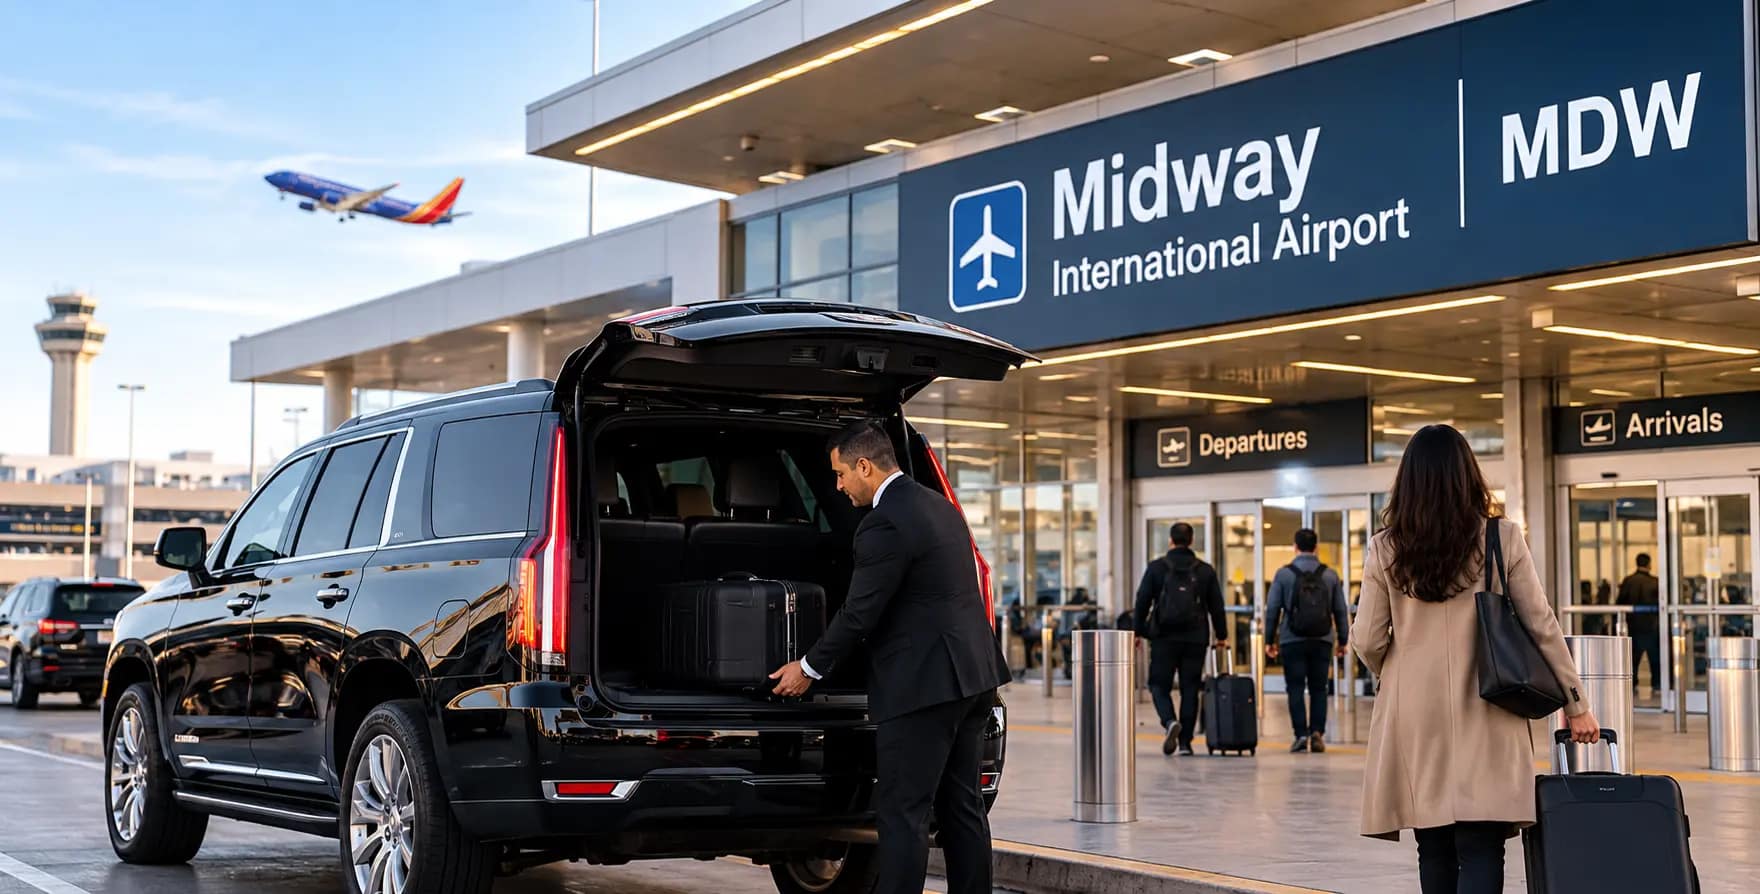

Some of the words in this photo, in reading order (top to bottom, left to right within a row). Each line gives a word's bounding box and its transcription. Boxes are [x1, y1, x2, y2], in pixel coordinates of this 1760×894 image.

[1502, 71, 1702, 184] MDW
[1053, 126, 1321, 240] Midway
[1053, 222, 1260, 297] International
[1272, 198, 1410, 261] Airport
[1199, 430, 1308, 459] Departures
[1626, 407, 1723, 438] Arrivals
